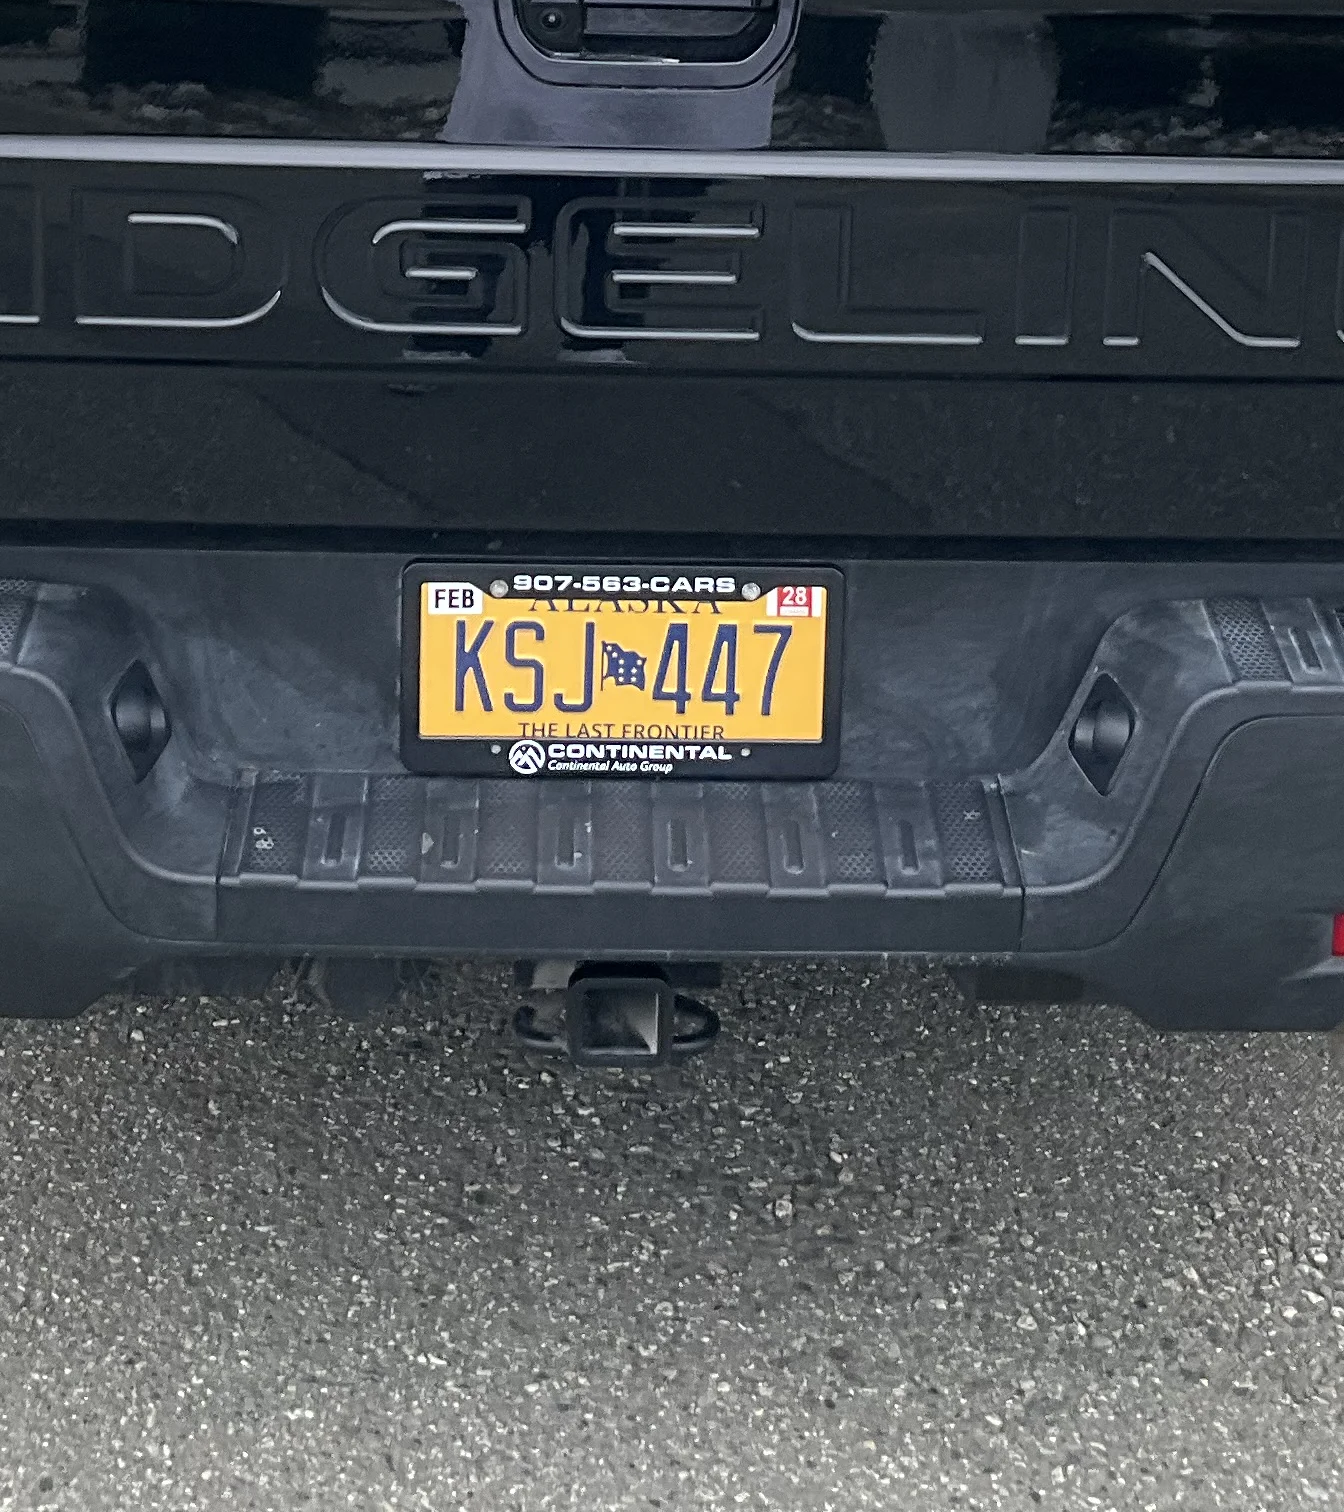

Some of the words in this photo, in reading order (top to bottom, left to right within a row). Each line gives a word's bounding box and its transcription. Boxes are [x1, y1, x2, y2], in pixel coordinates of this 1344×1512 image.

[513, 574, 736, 594] 907-563-CARS
[435, 589, 474, 609] FEB
[783, 587, 808, 606] 28
[455, 619, 595, 713] KSJ
[652, 622, 793, 716] 447
[518, 722, 558, 738] THE
[566, 723, 615, 739] LAST
[622, 724, 725, 740] FRONTIER
[547, 743, 733, 761] CONTINENTAL
[547, 760, 609, 772] Continental
[610, 761, 638, 772] Auto
[639, 761, 674, 774] Group
